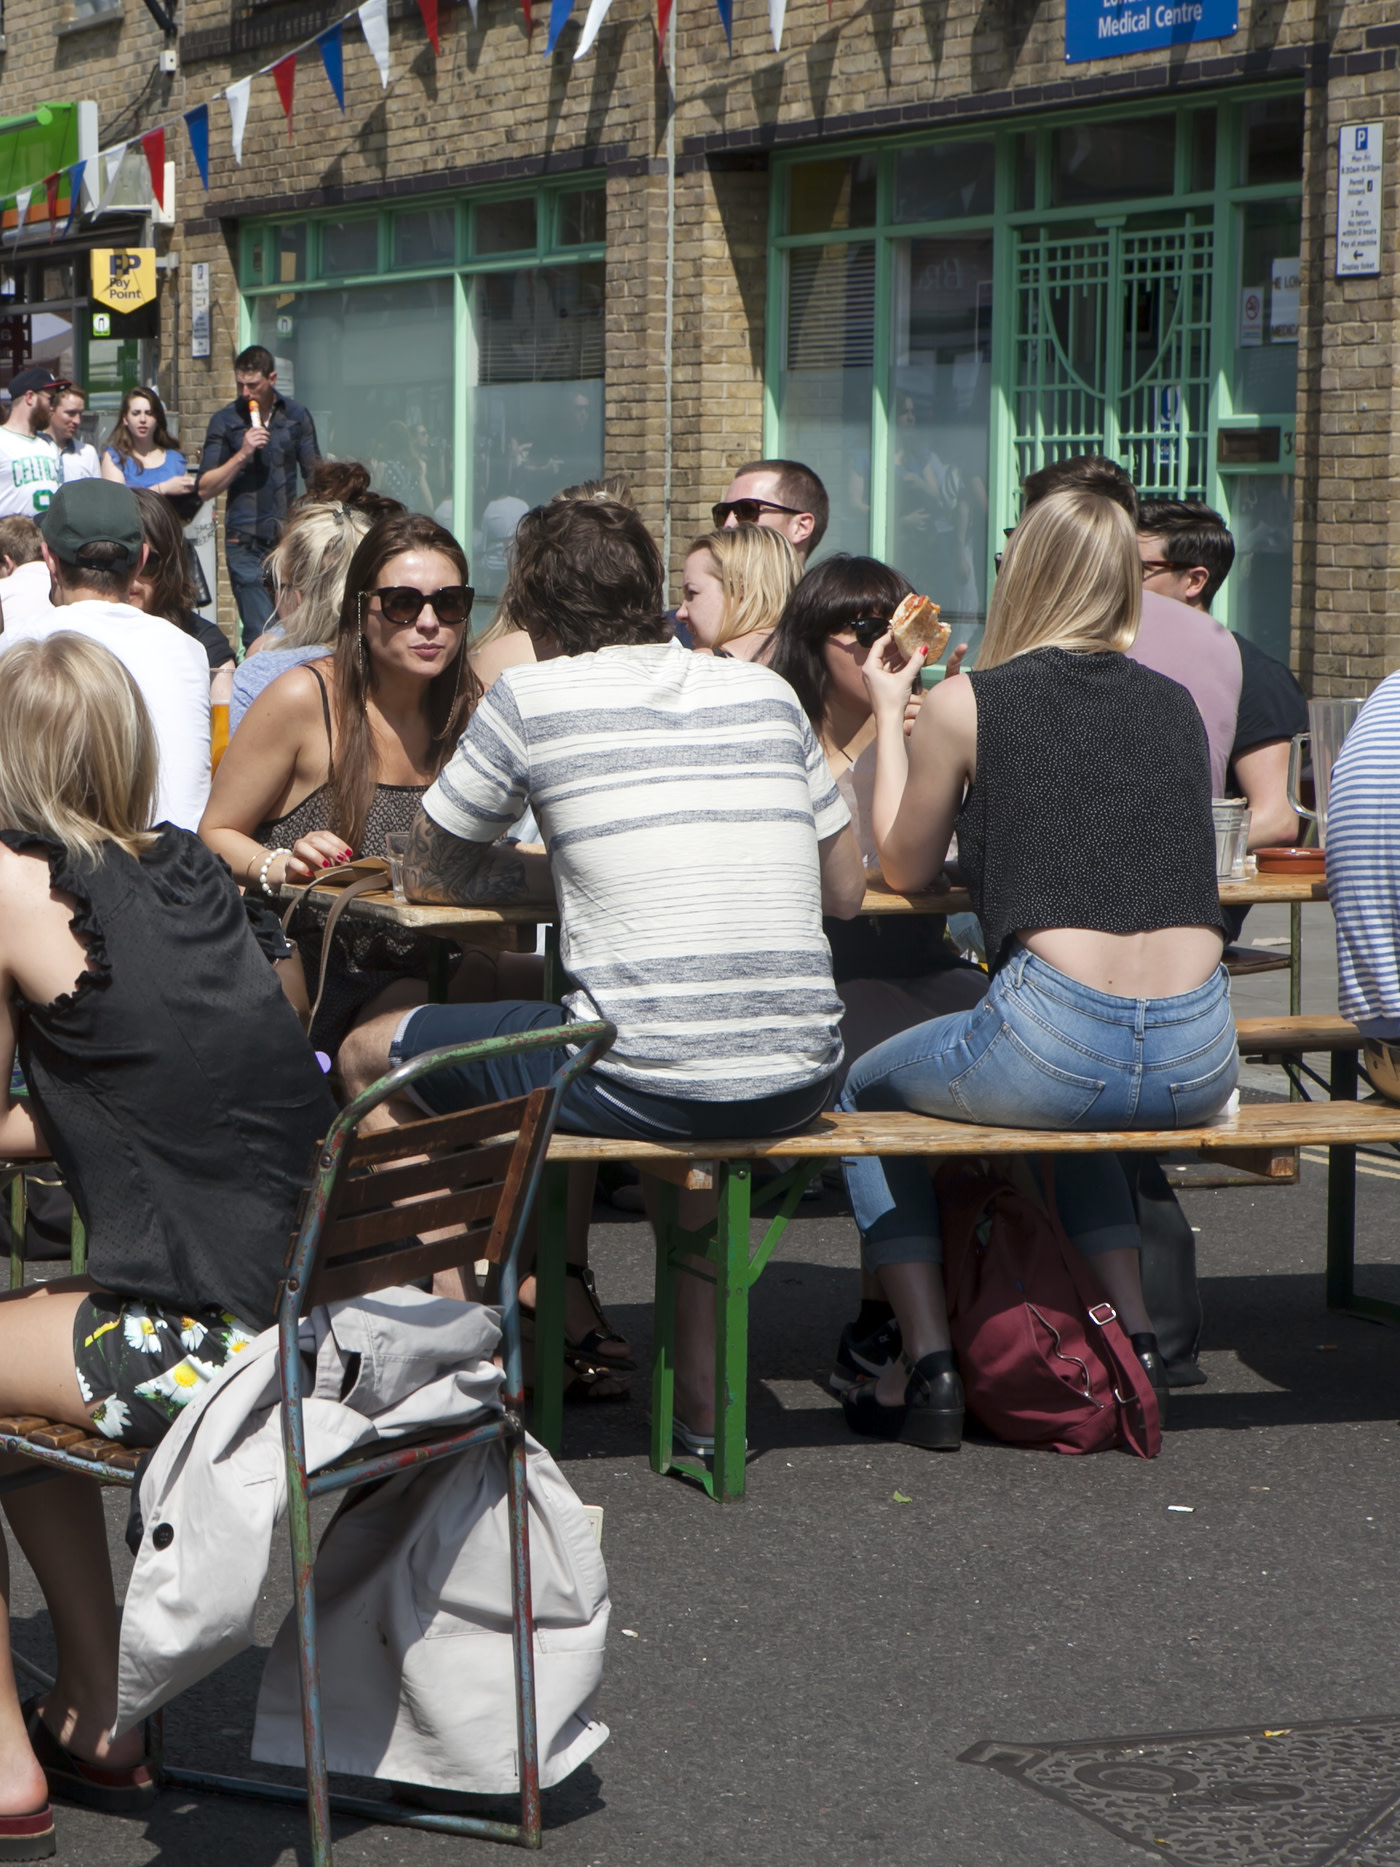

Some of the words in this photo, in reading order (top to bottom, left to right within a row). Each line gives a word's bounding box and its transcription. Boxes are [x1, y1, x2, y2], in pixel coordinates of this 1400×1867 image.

[1098, 7, 1151, 39] Medical
[1154, 4, 1202, 29] Centre
[110, 278, 131, 290] Pay
[110, 290, 142, 299] Point
